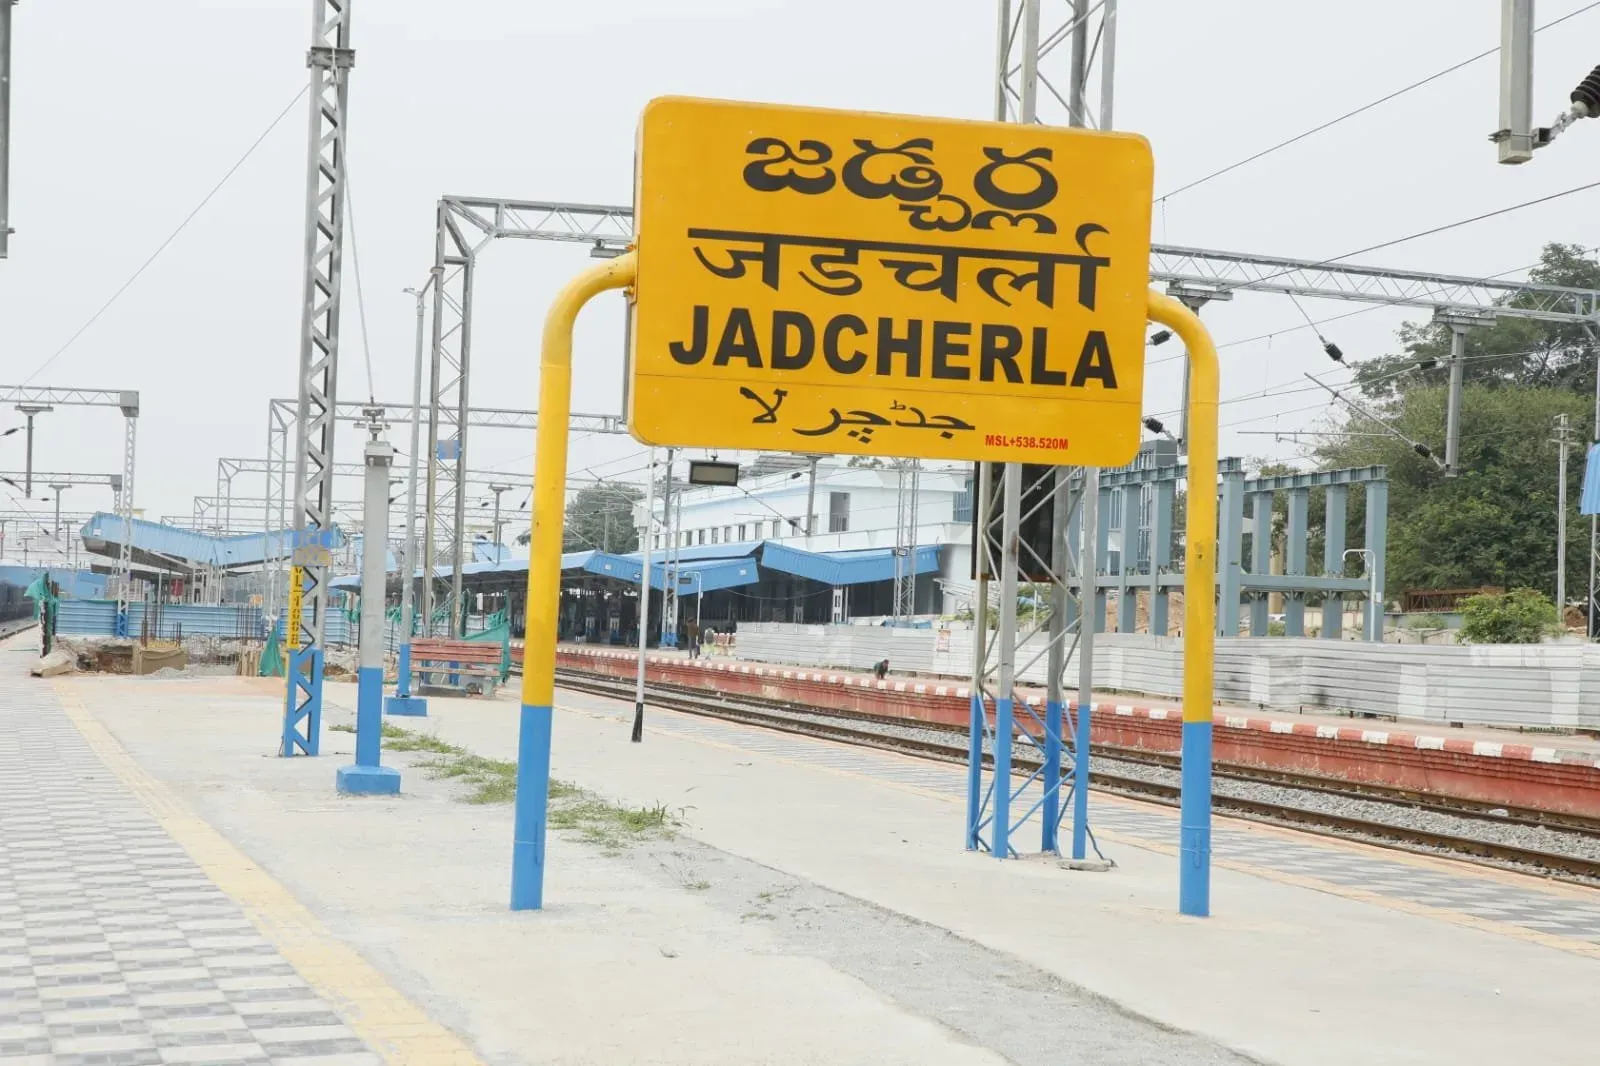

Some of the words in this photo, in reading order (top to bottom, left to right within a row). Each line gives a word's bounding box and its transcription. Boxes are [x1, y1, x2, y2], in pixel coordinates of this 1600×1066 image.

[742, 137, 1059, 235] జడ్చర్ల
[687, 223, 1110, 312] जडचर्ला
[668, 304, 1119, 390] JADCHERLA
[984, 434, 1070, 451] MSL+538.520M
